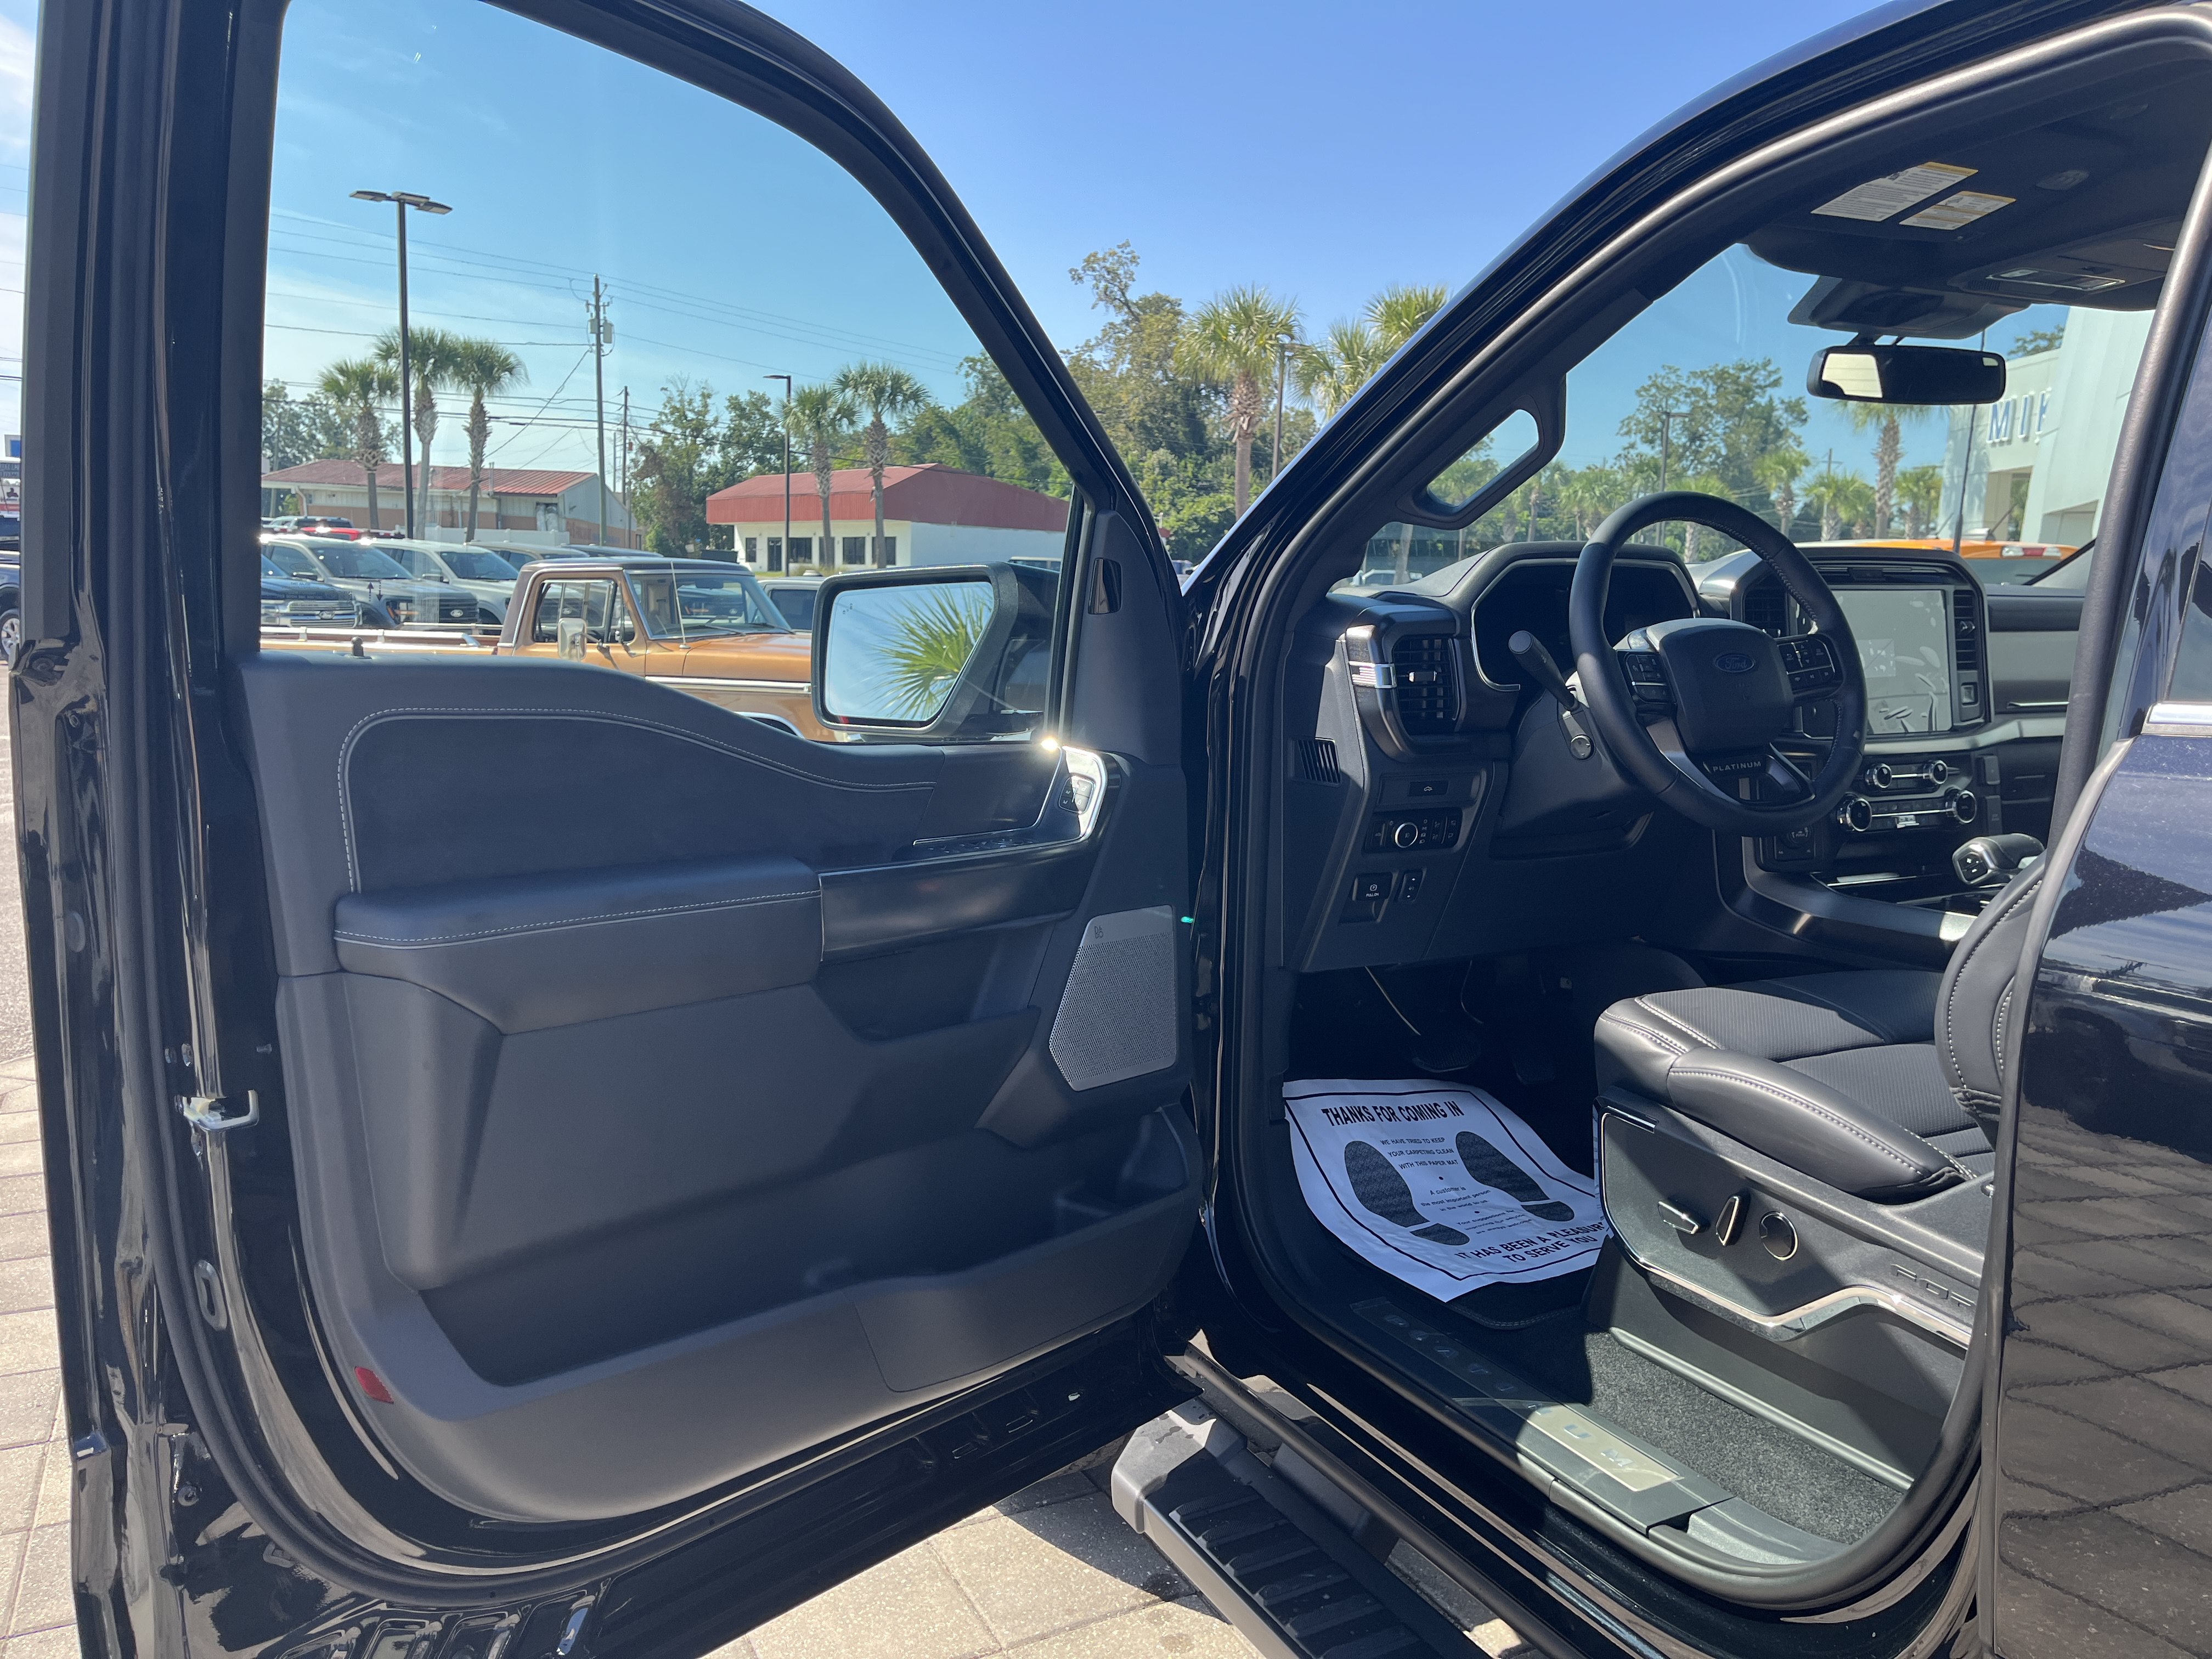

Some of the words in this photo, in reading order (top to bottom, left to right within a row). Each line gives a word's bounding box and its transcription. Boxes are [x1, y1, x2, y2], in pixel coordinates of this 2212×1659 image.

[1724, 657, 1747, 670] Ford
[1712, 761, 1762, 772] PLATINUM
[1321, 1105, 1375, 1126] THANKS
[1372, 1105, 1401, 1122] FOR
[1397, 1102, 1448, 1122] COMING
[1443, 1100, 1465, 1117] IN
[1398, 1161, 1415, 1170] WITH
[1445, 1194, 1472, 1203] important
[1472, 1189, 1491, 1198] person
[1470, 1246, 1502, 1258] HAS
[1499, 1238, 1539, 1251] BEEN
[1502, 1254, 1527, 1263] TO
[1524, 1240, 1571, 1258] SERVE
[1570, 1235, 1598, 1244] YOU
